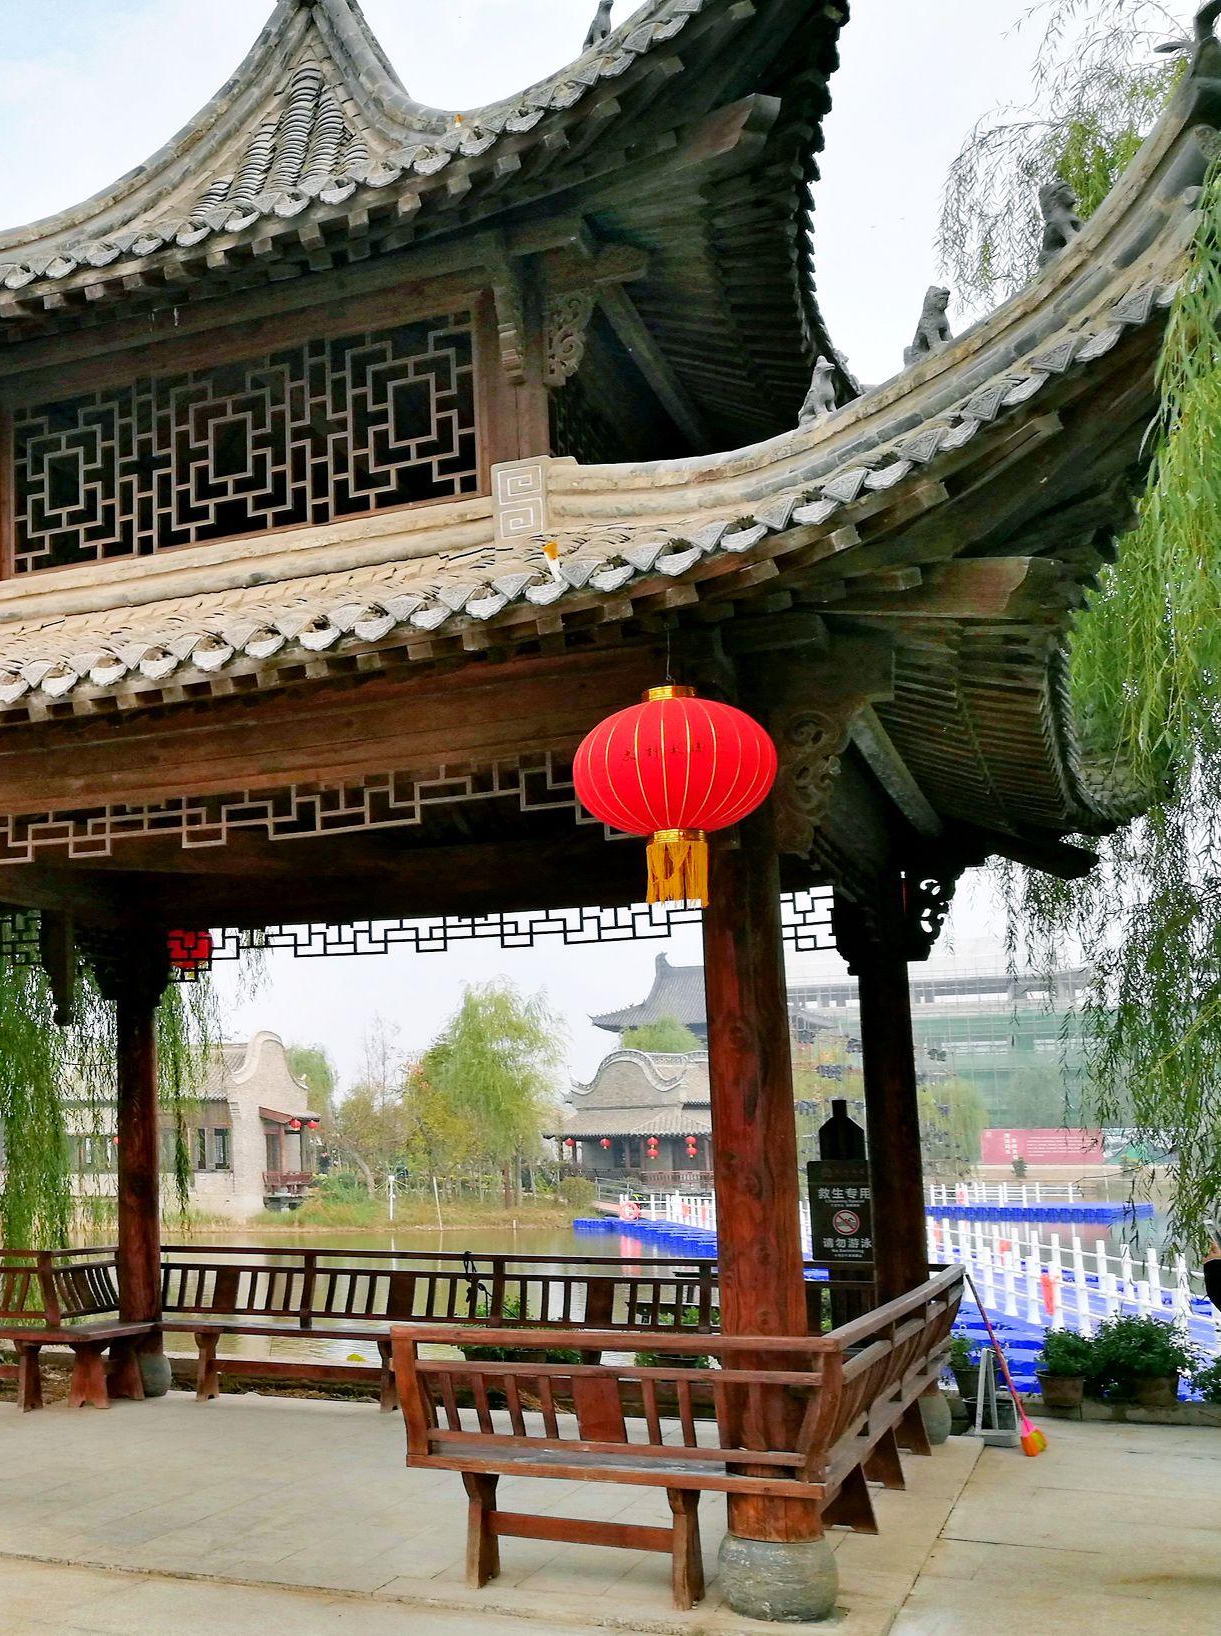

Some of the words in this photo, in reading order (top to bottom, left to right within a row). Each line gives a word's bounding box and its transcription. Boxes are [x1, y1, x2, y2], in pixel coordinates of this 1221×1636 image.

[818, 1187, 871, 1199] 救生专用
[822, 1237, 872, 1248] 请勿游泳
